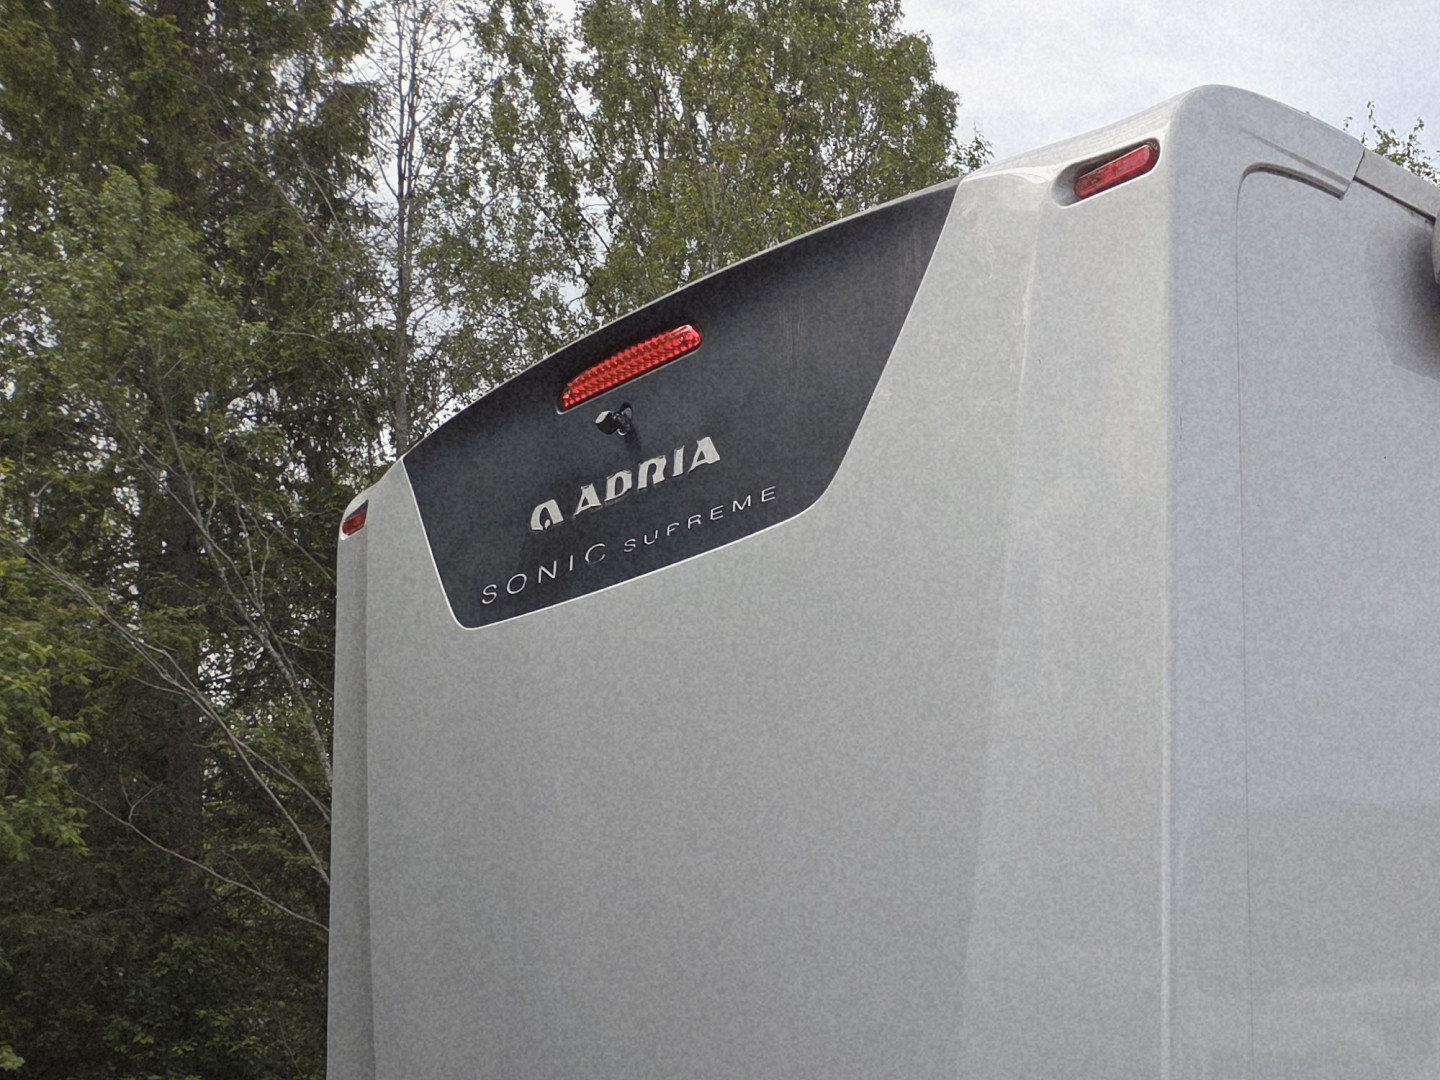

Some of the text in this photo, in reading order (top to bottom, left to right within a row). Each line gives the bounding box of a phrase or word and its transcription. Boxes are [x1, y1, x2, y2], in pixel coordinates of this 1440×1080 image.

[573, 436, 721, 519] ADRIA
[481, 485, 777, 605] SONIC SUPREME
